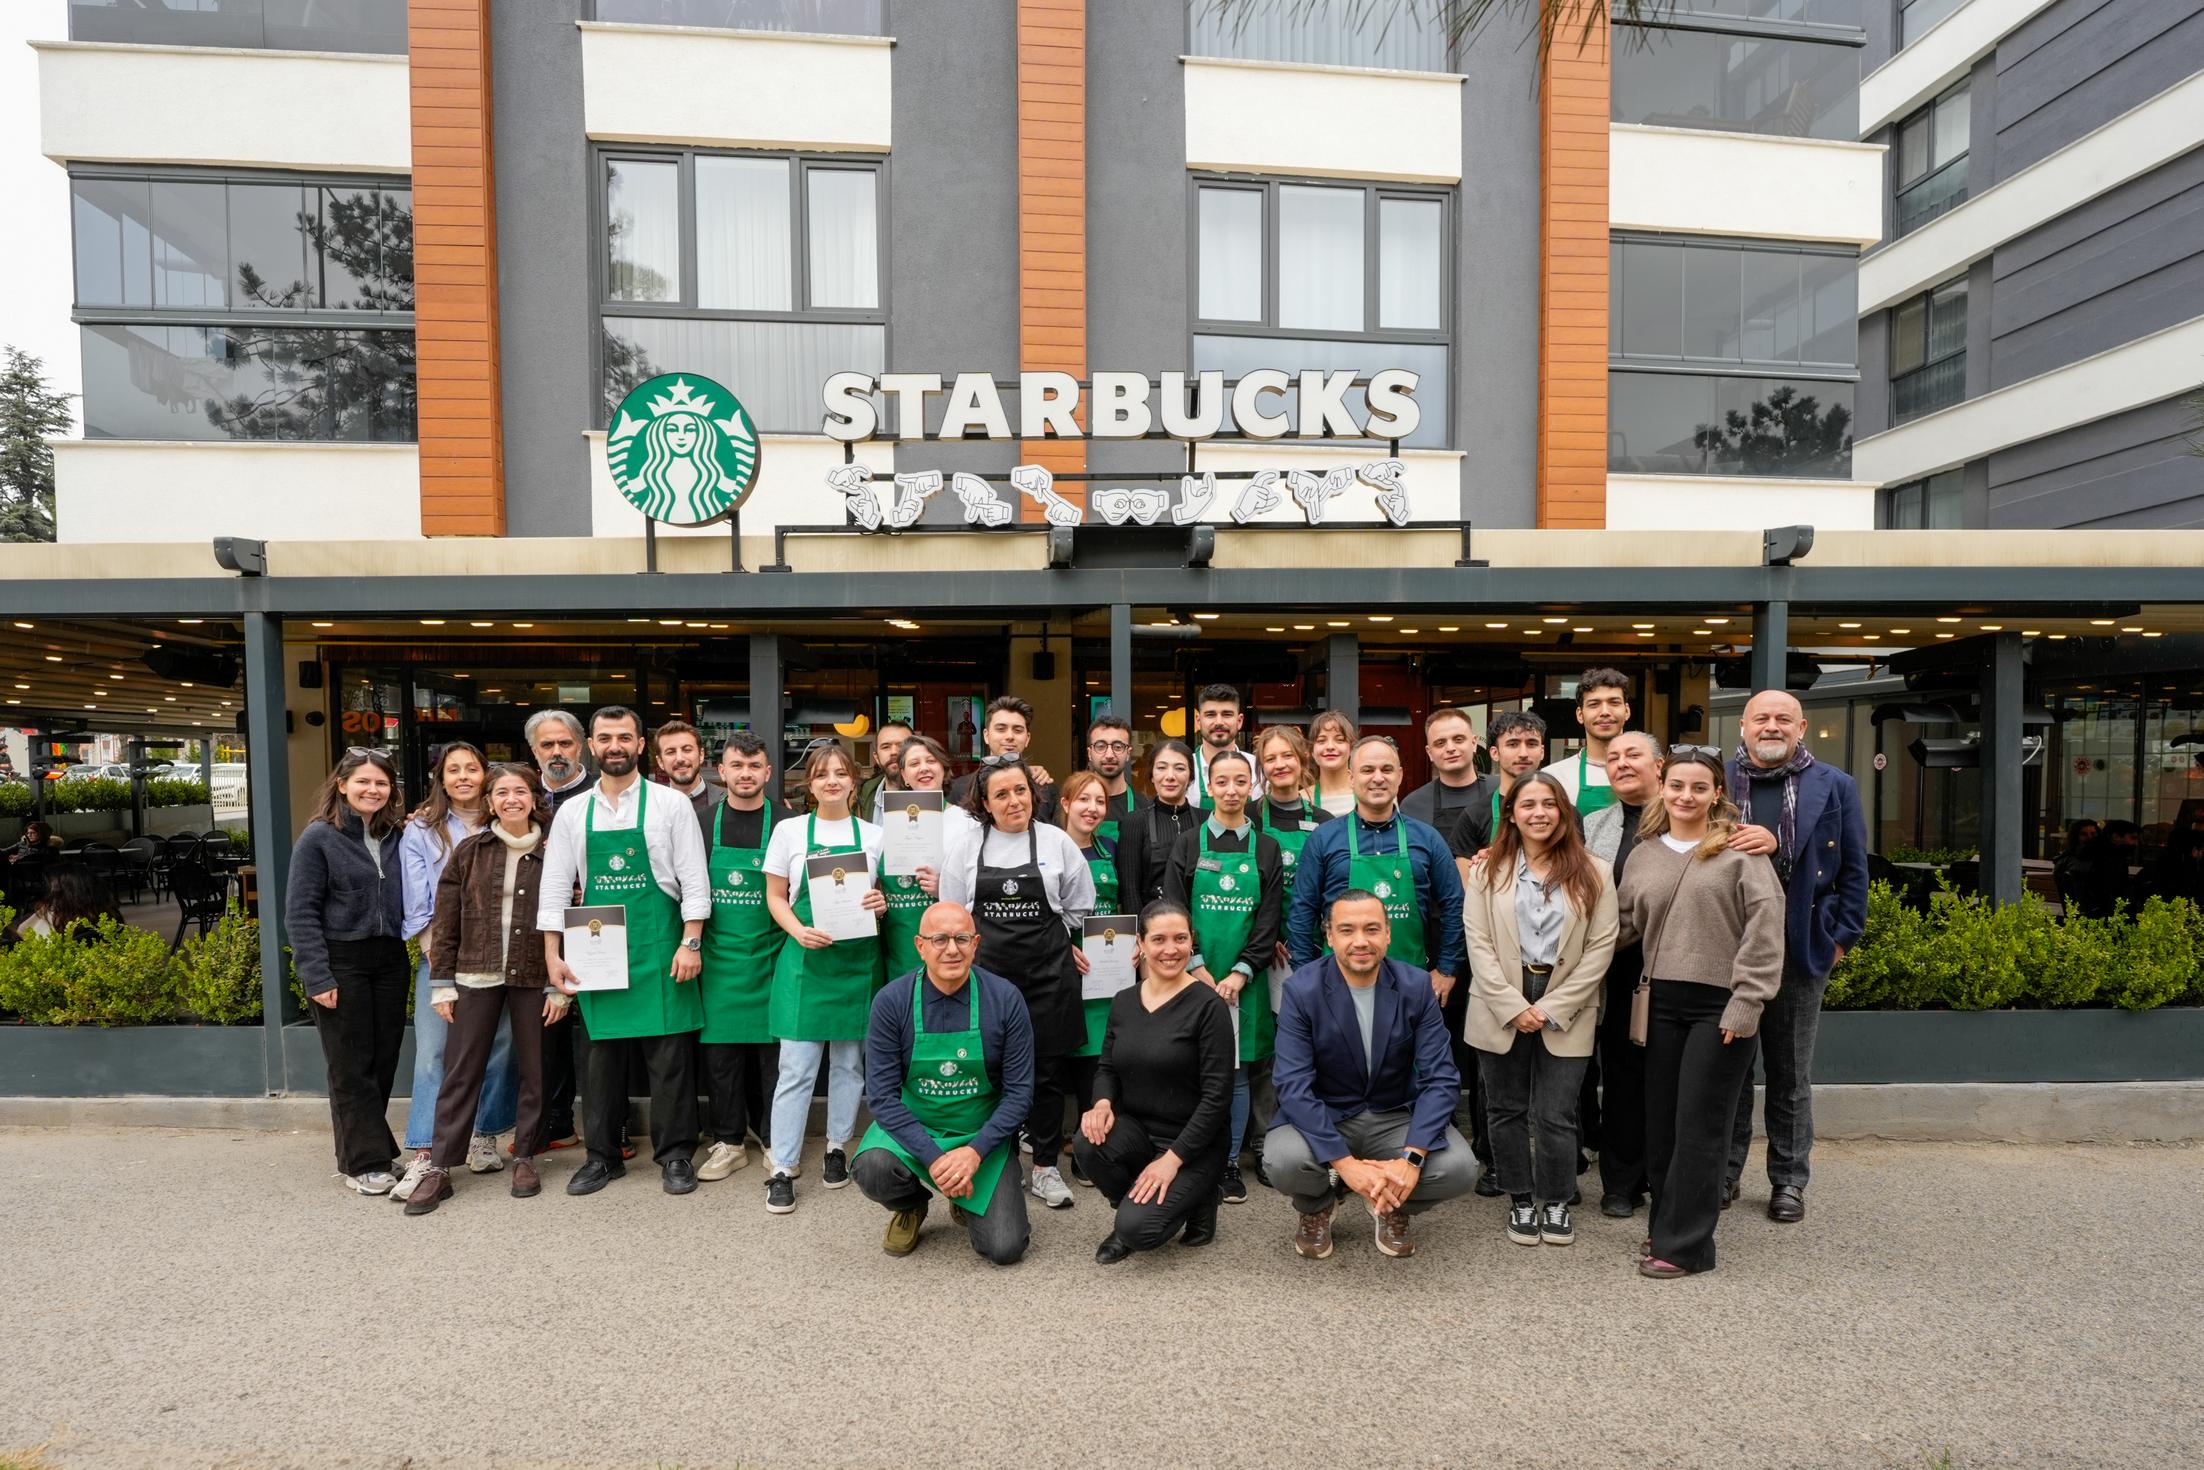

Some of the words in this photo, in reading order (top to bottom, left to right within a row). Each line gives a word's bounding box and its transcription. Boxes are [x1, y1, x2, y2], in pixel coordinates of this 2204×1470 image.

[822, 369, 1421, 441] STARBUCKS
[595, 882, 647, 891] STARBUCKS
[1200, 904, 1252, 912] STARBUCKS
[918, 1087, 978, 1096] STARBUCKS
